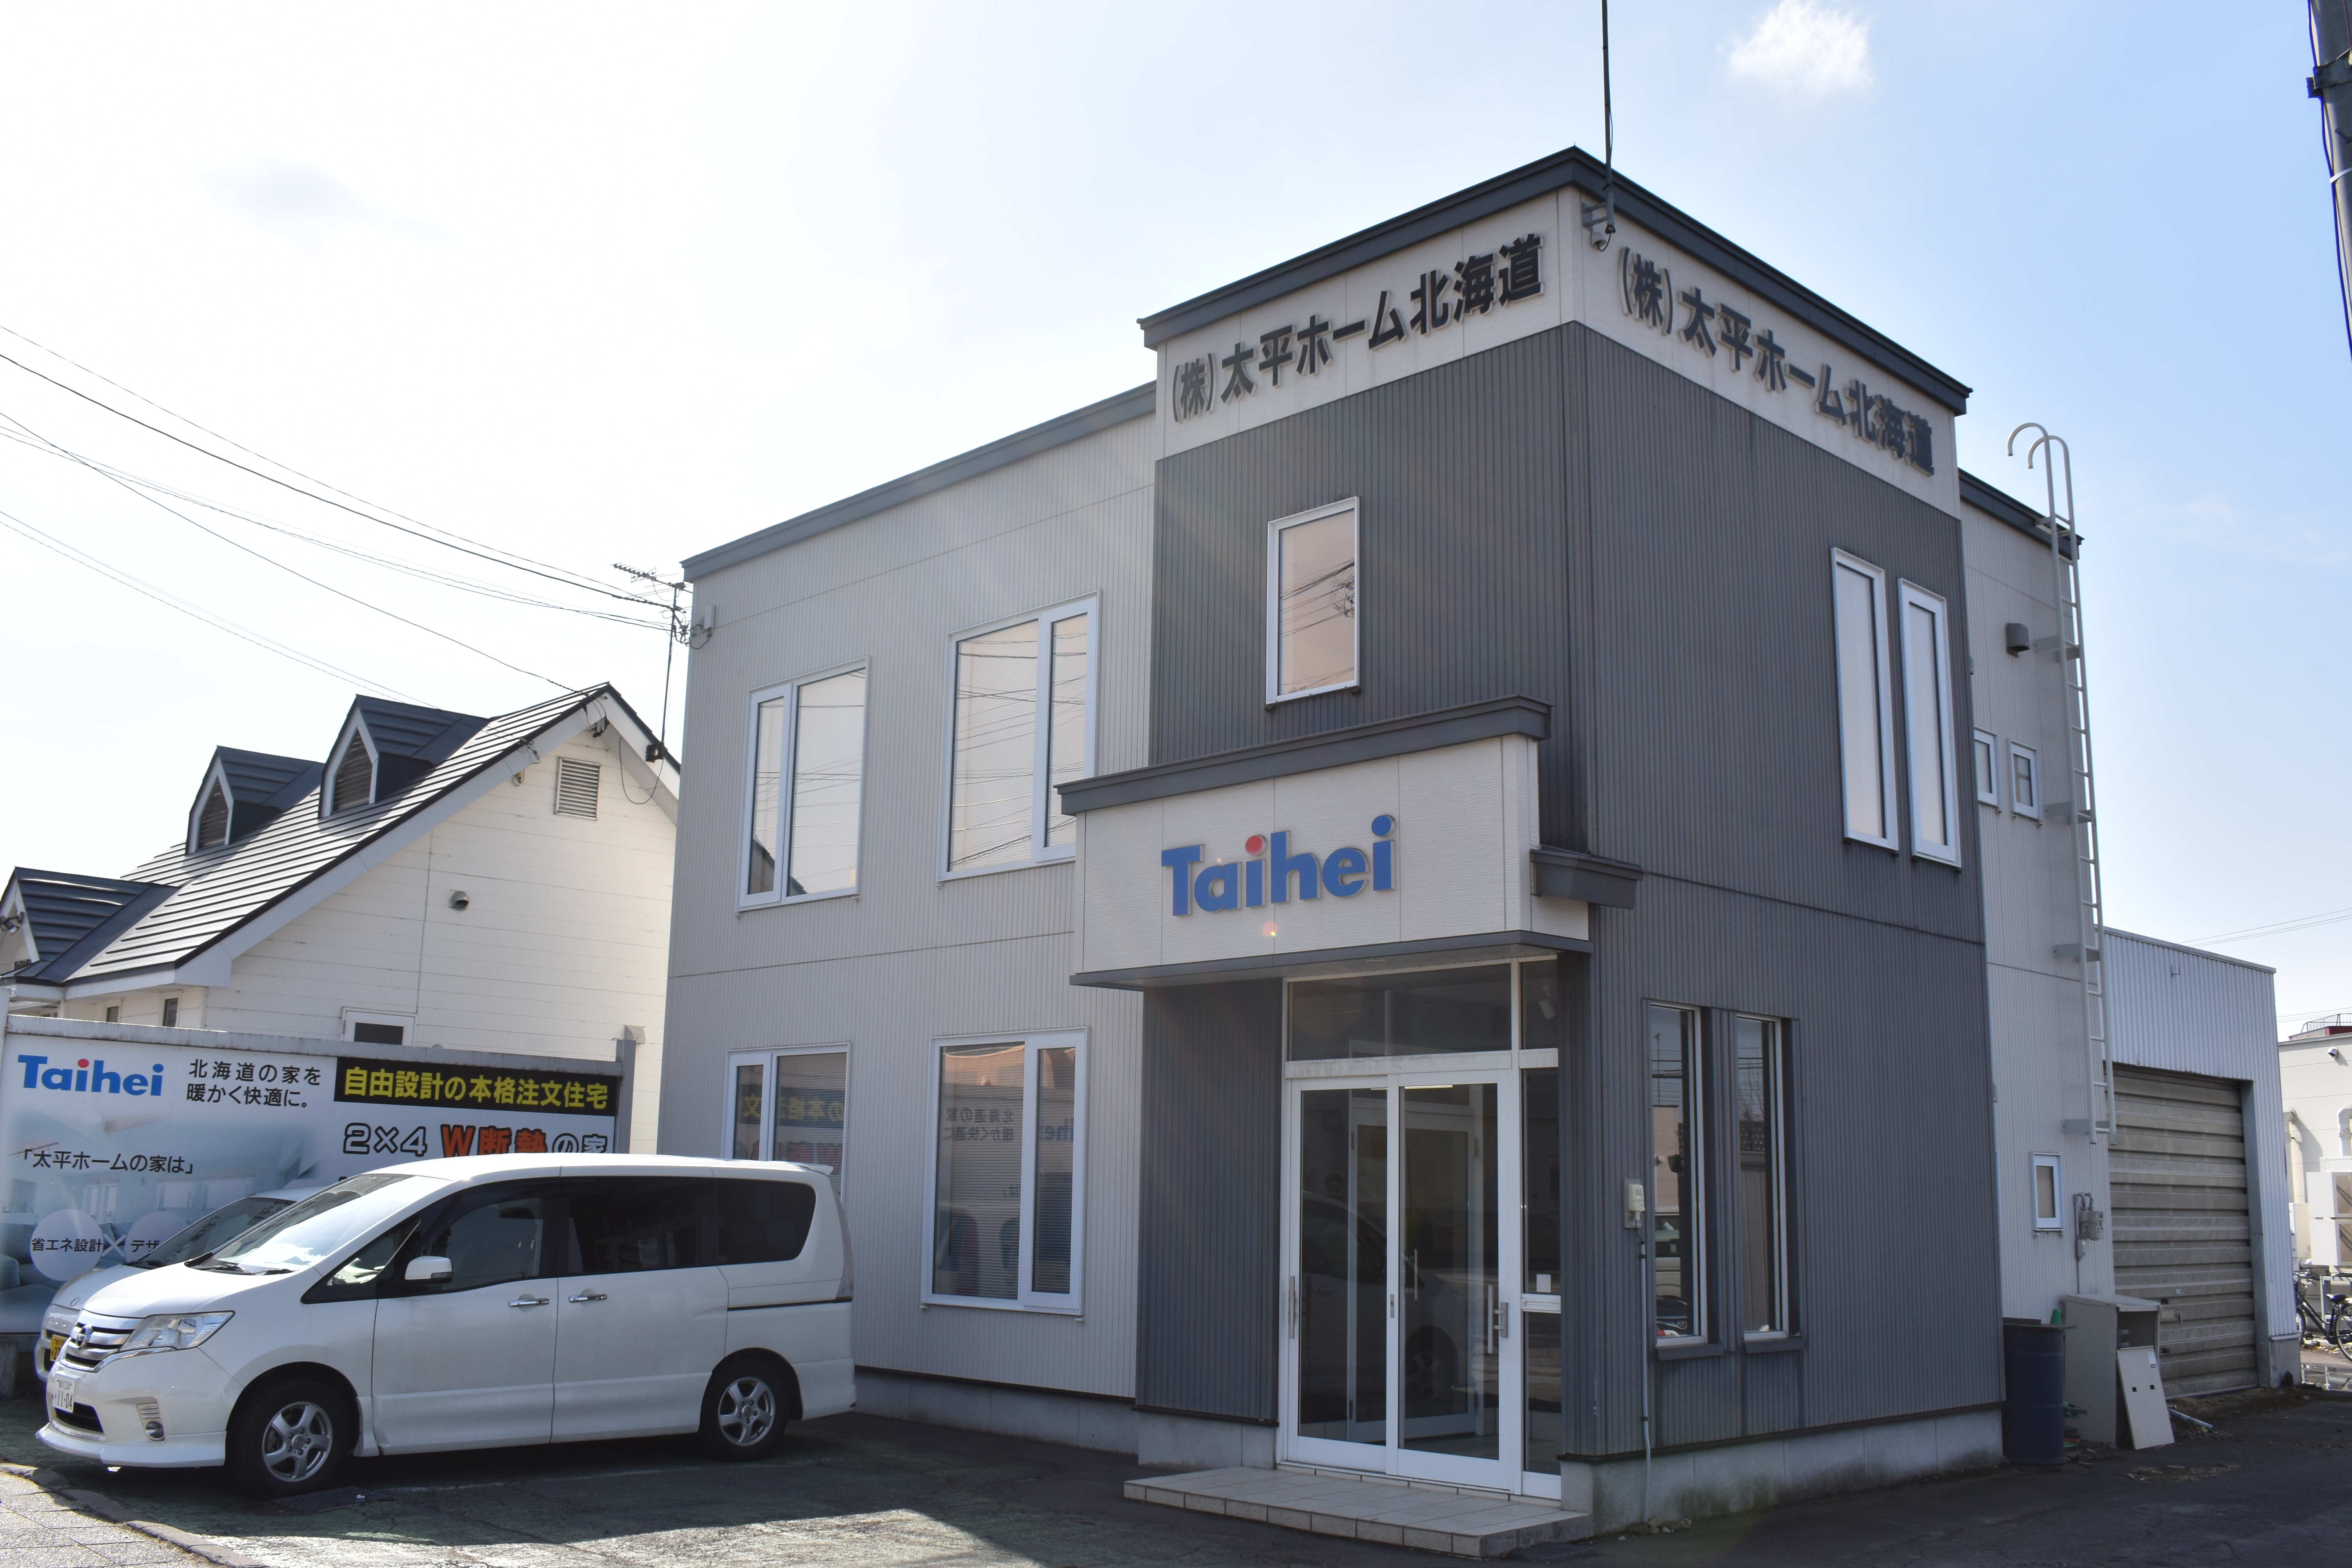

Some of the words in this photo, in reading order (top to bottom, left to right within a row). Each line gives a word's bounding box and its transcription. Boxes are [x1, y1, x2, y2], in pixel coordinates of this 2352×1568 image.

[1172, 234, 1544, 422] (株)太平ホーム北海道
[1618, 247, 1934, 476] (株)太平ホーム北海道
[1161, 814, 1395, 916] Taihei
[18, 1054, 164, 1096] Taihei
[189, 1058, 321, 1085] 北海道の家を
[344, 1066, 608, 1109] 自由設計の本格注文住宅
[186, 1083, 307, 1108] 暖かく快適に。
[24, 1149, 194, 1174] 「太平ホームの家は」
[31, 1238, 103, 1252] 省エネ設計
